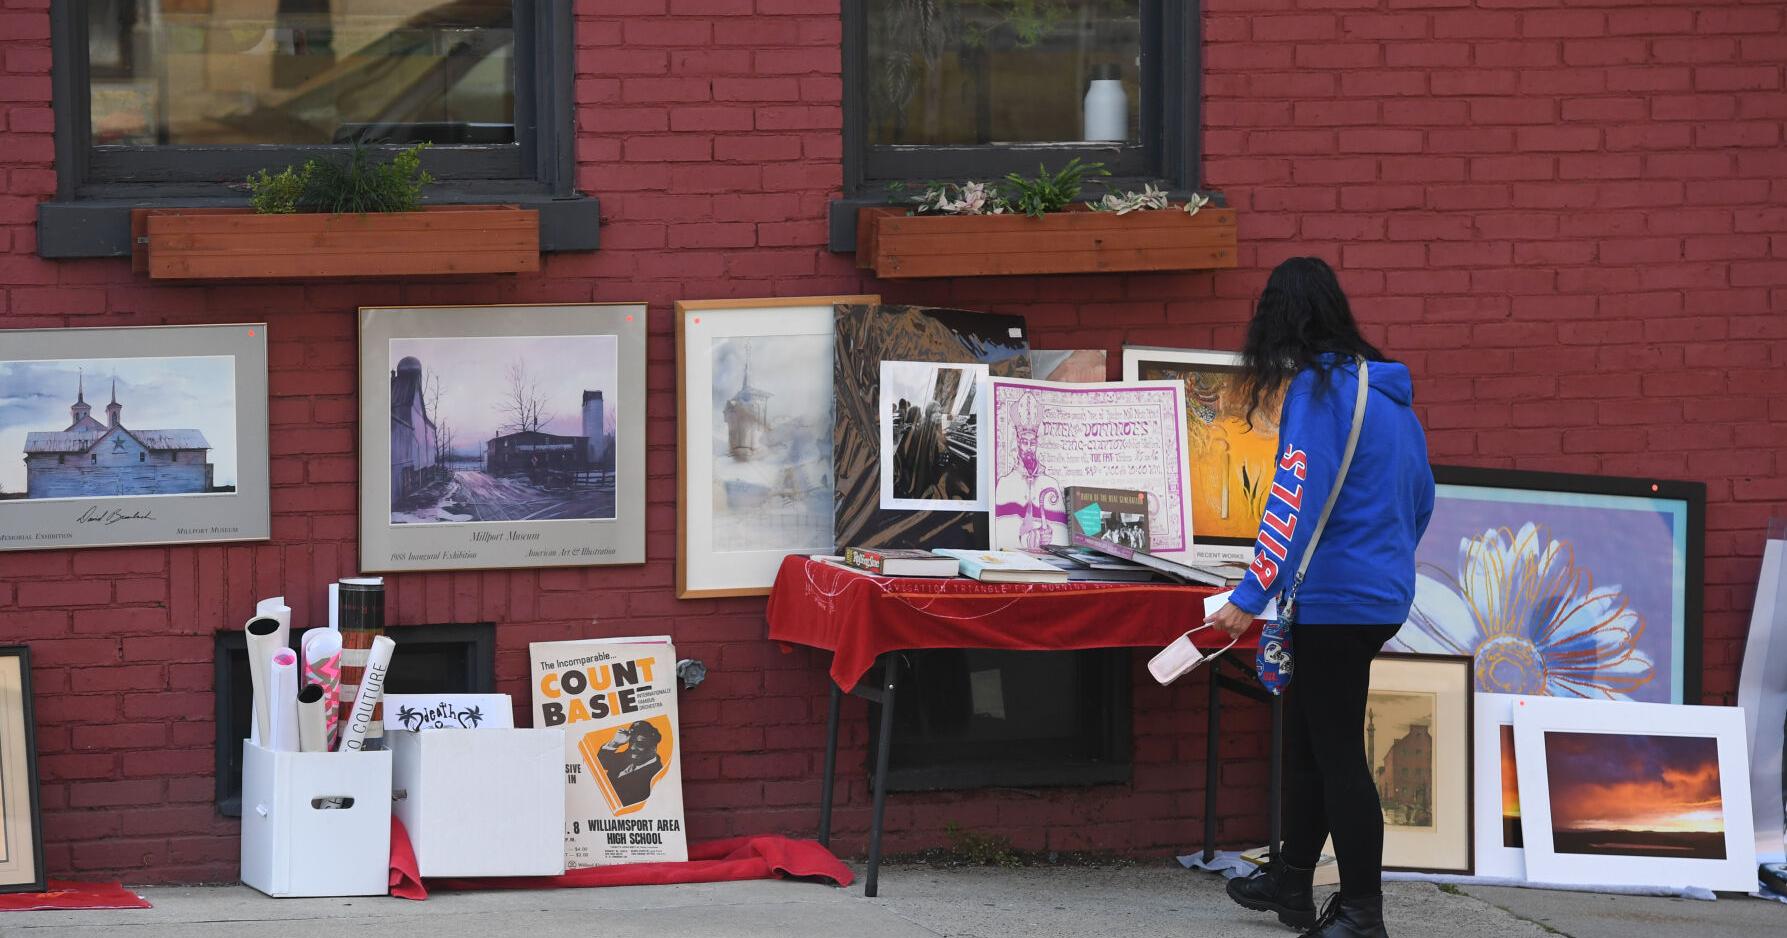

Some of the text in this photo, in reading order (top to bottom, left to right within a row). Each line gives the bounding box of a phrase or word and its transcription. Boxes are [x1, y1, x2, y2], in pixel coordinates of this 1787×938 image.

[1249, 443, 1308, 591] BILLS
[176, 527, 208, 535] MILLPORT
[470, 530, 540, 543] Millport Museum
[408, 552, 441, 561] Inaugural
[442, 551, 477, 559] Exhibition
[525, 549, 557, 557] American
[580, 547, 616, 556] Illustration
[954, 585, 1007, 593] TRIANGLE
[540, 652, 617, 671] The Incomparable...
[540, 656, 656, 699] COUNT
[352, 662, 386, 734] COUTURE
[424, 702, 457, 723] death
[541, 688, 639, 728] BASIE
[588, 819, 680, 832] WILLIAMSPORT AREA
[607, 832, 663, 845] HIGH SCHOOL
